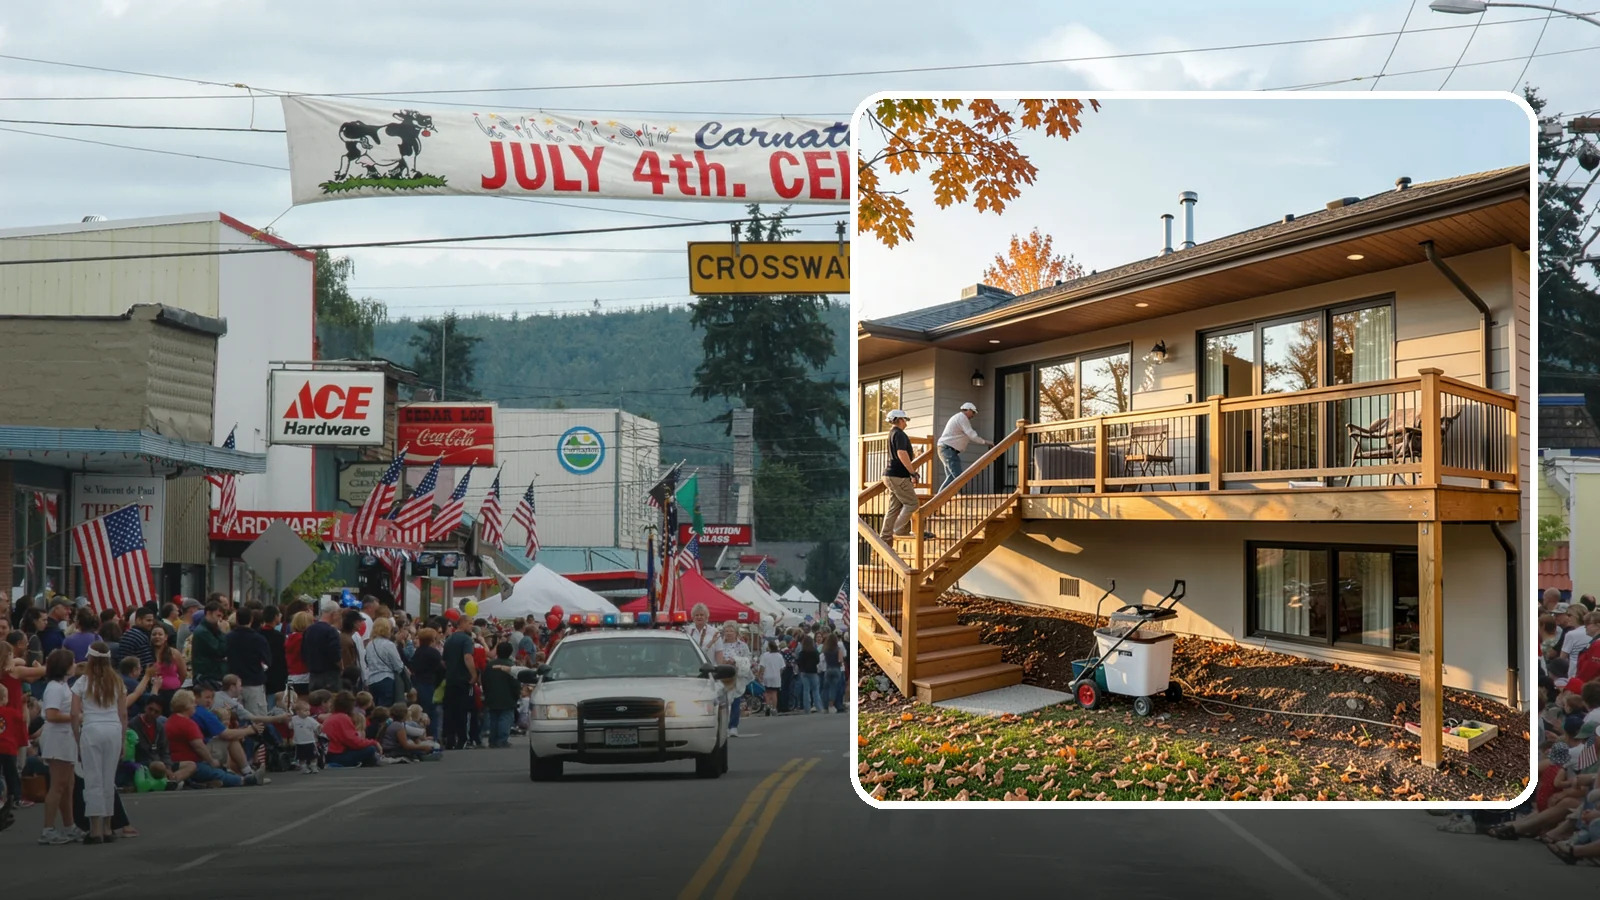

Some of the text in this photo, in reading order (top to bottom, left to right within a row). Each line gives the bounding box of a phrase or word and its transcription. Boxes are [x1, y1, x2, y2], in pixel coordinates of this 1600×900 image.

[695, 121, 850, 150] Carnat
[481, 141, 605, 192] JULY
[632, 150, 746, 198] 4th.
[697, 254, 850, 280] CROSSWA
[282, 380, 373, 420] ACE
[406, 409, 452, 422] CEDAR
[283, 421, 371, 436] Hardware
[416, 428, 477, 447] Coca-Cola
[353, 467, 385, 480] Simpl
[96, 485, 124, 495] Vincent
[126, 486, 136, 495] de
[138, 485, 155, 495] Paul
[81, 503, 154, 522] THT
[212, 515, 331, 536] HARDARE
[688, 526, 741, 535] CRNATION
[699, 535, 730, 543] GLASS
